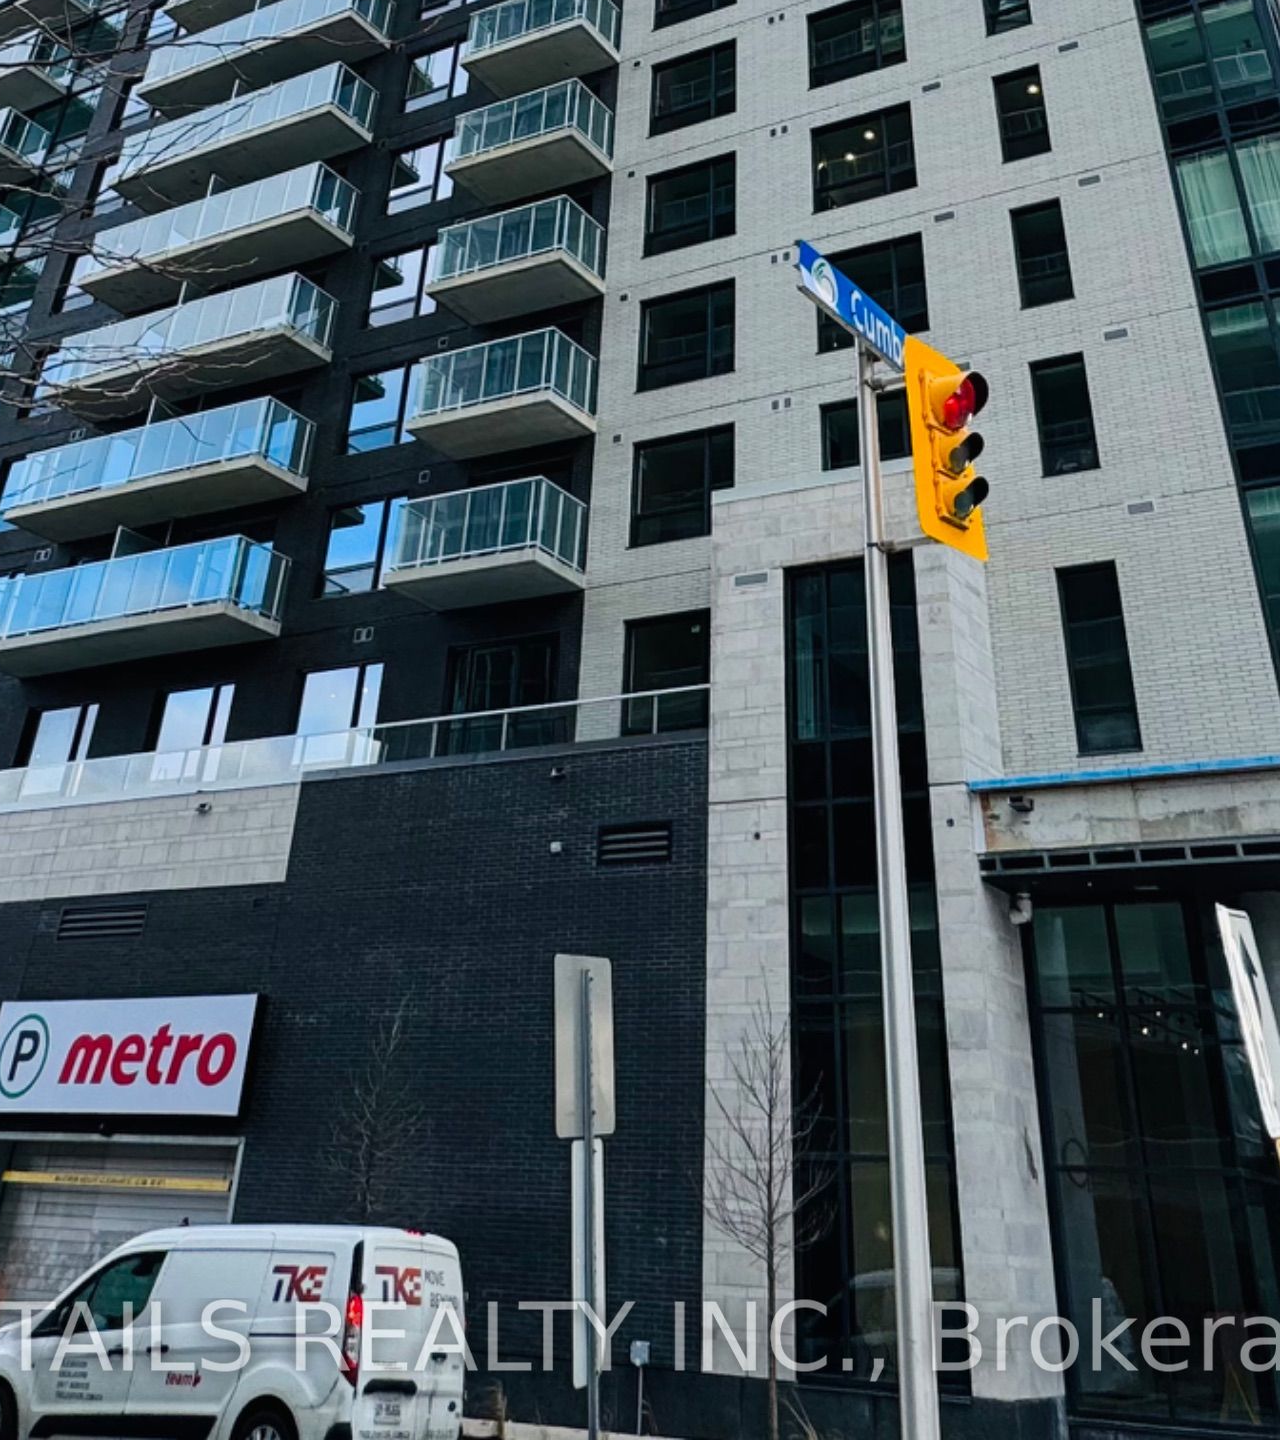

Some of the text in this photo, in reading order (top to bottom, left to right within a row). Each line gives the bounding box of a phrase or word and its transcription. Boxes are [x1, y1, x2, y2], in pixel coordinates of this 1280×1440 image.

[57, 1023, 237, 1087] metro
[272, 1265, 328, 1302] TKE
[374, 1264, 423, 1306] TKE
